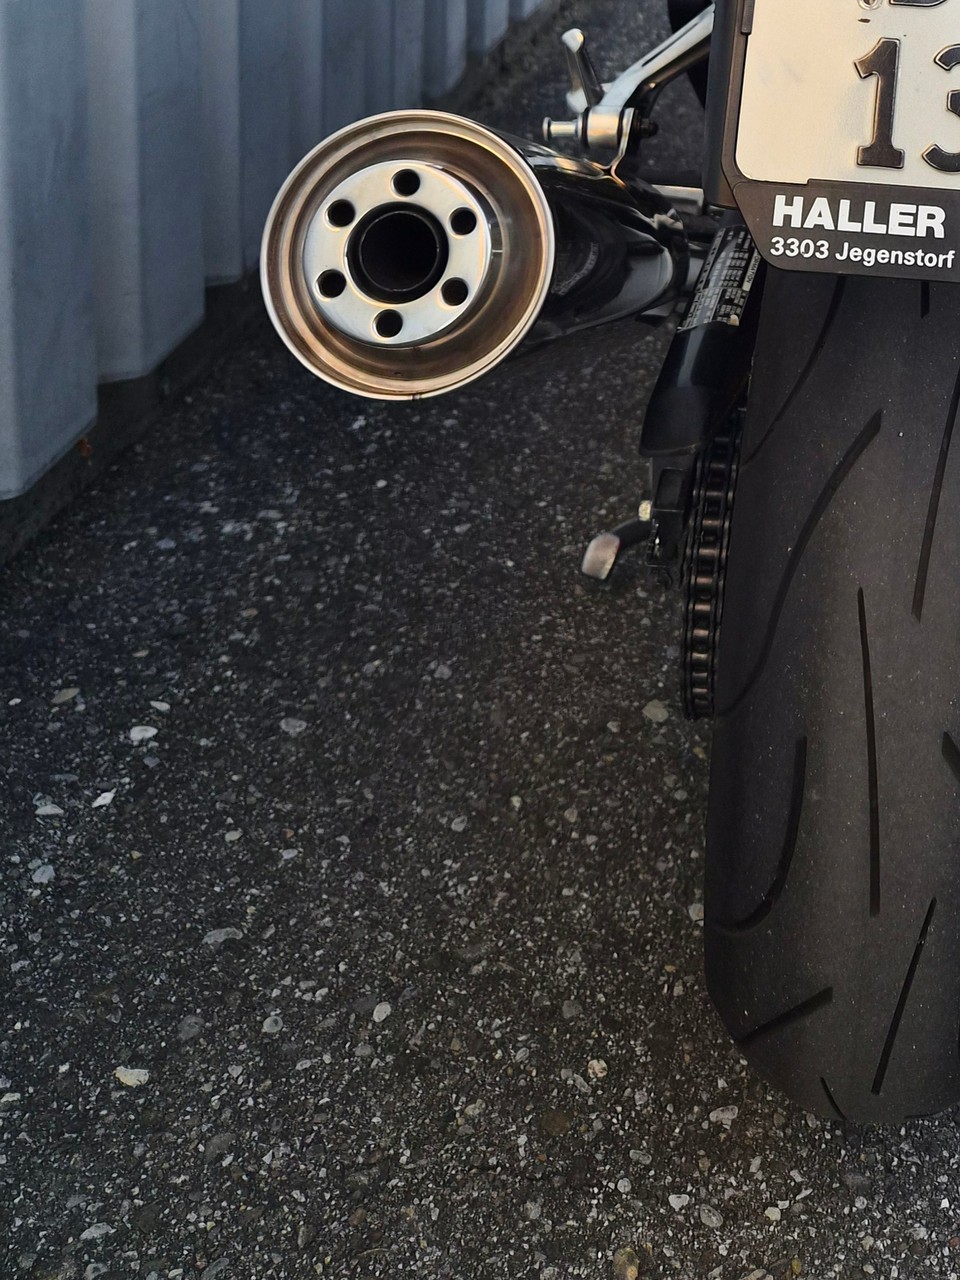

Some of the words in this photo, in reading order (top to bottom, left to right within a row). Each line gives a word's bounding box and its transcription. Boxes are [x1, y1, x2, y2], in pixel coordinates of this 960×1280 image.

[772, 194, 946, 239] HALLER
[769, 236, 830, 260] 3303
[835, 241, 955, 269] Jegenstorf
